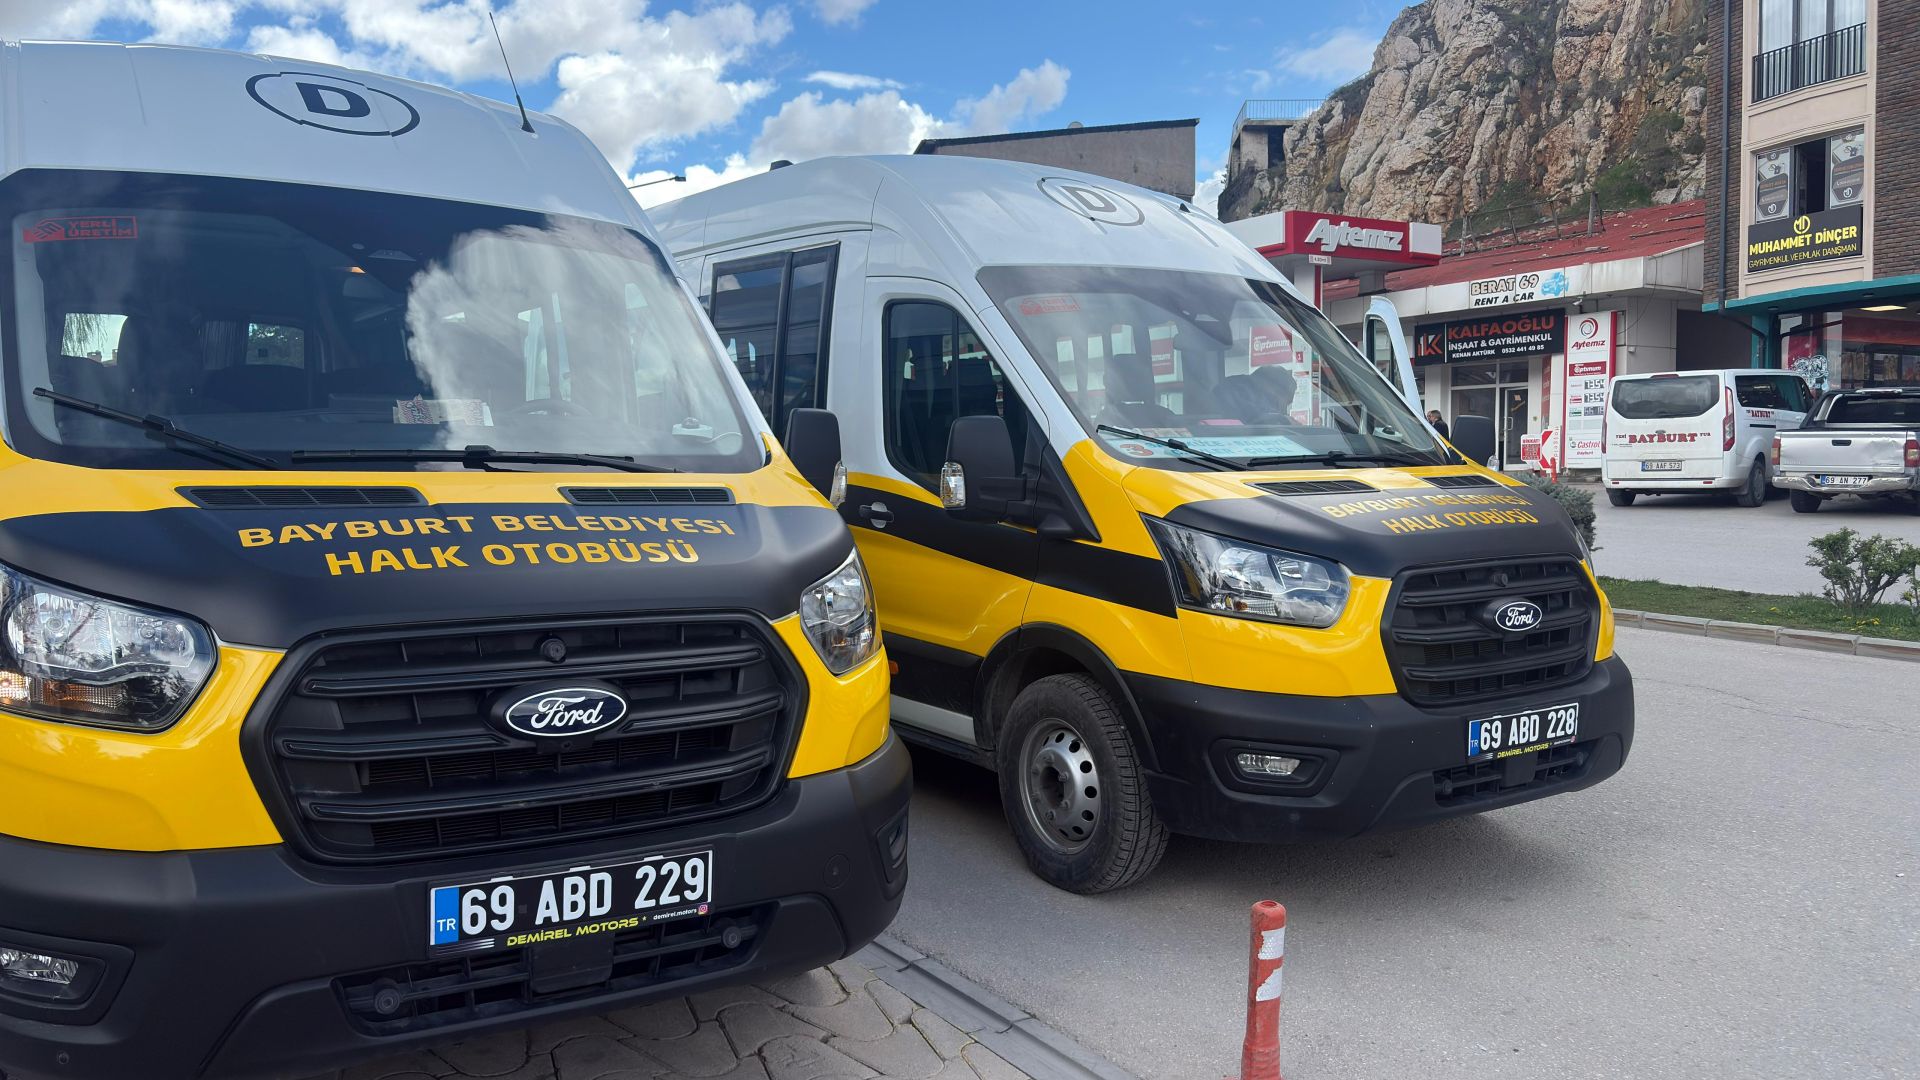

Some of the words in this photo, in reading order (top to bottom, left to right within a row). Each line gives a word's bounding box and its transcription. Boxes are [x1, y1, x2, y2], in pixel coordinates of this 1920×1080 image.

[296, 82, 371, 118] D
[1062, 186, 1117, 213] D
[1304, 218, 1404, 252] Aytemiz
[1749, 234, 1813, 255] MUHAMMET
[1815, 225, 1857, 244] DİNÇER
[1470, 277, 1516, 296] BERAT
[1518, 274, 1540, 290] 69
[1474, 297, 1499, 307] RENT
[1501, 296, 1509, 304] A
[1513, 292, 1534, 302] CAR
[1448, 314, 1555, 340] KALFAOĞLU
[1448, 340, 1479, 352] İNŞAAT
[1480, 339, 1487, 348] &
[1488, 333, 1552, 347] GAYRİMENKUL
[1571, 340, 1606, 351] Aytemiz
[1577, 440, 1601, 449] Castrol
[1628, 432, 1698, 443] BAYBURT
[1321, 496, 1427, 518] BAYBURT
[238, 515, 475, 548] BAYBURT
[491, 515, 736, 536] BELEDİYESİ
[1381, 514, 1450, 534] HALK
[1443, 508, 1538, 527] OTOBÜSÜ
[324, 545, 469, 576] HALK
[481, 540, 700, 566] OTOBÜSÜ
[1505, 606, 1533, 627] Ford
[530, 696, 603, 729] Ford
[1480, 720, 1502, 750] 69
[1508, 714, 1540, 746] ABD
[1546, 708, 1576, 739] 228
[1497, 747, 1523, 759] DEMİREL
[1523, 742, 1549, 753] MOTORS
[437, 918, 457, 932] TR
[461, 885, 515, 935] 69
[535, 871, 613, 925] ABD
[634, 857, 705, 910] 229
[506, 927, 572, 947] DEMİREL
[576, 917, 640, 936] MOTORS
